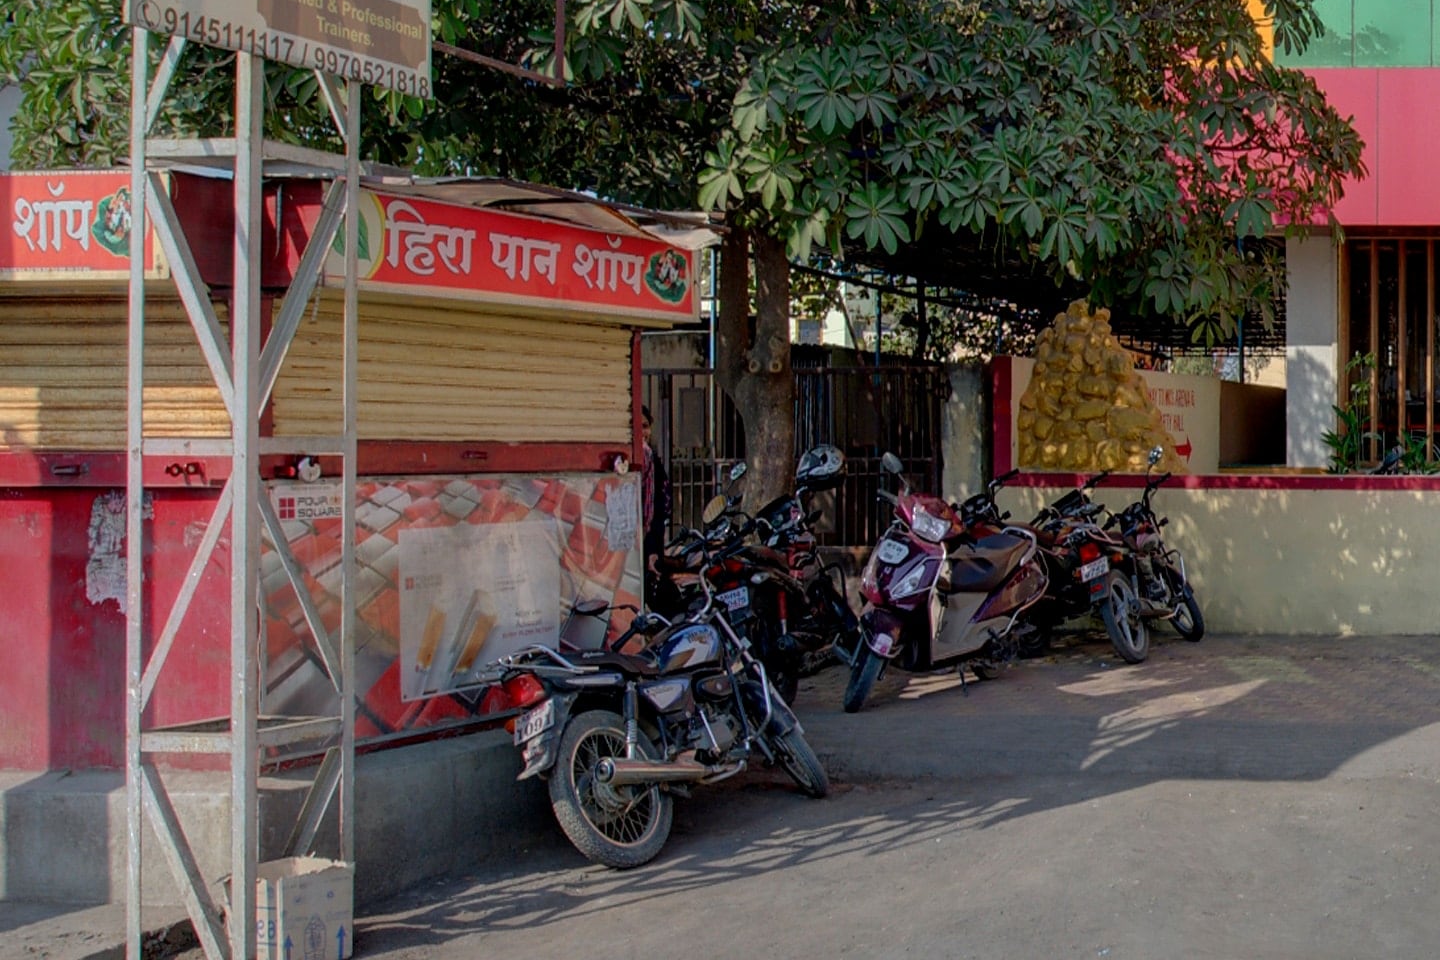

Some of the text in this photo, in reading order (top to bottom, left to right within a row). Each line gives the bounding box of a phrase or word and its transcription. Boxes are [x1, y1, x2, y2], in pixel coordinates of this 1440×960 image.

[164, 7, 295, 61] 9145111117
[316, 15, 375, 47] Trainers.
[342, 0, 423, 40] Professional
[12, 180, 94, 252] शॉप
[384, 199, 645, 296] हिरा पान शॉप
[297, 495, 329, 507] FOUR
[297, 506, 342, 518] SQUARE
